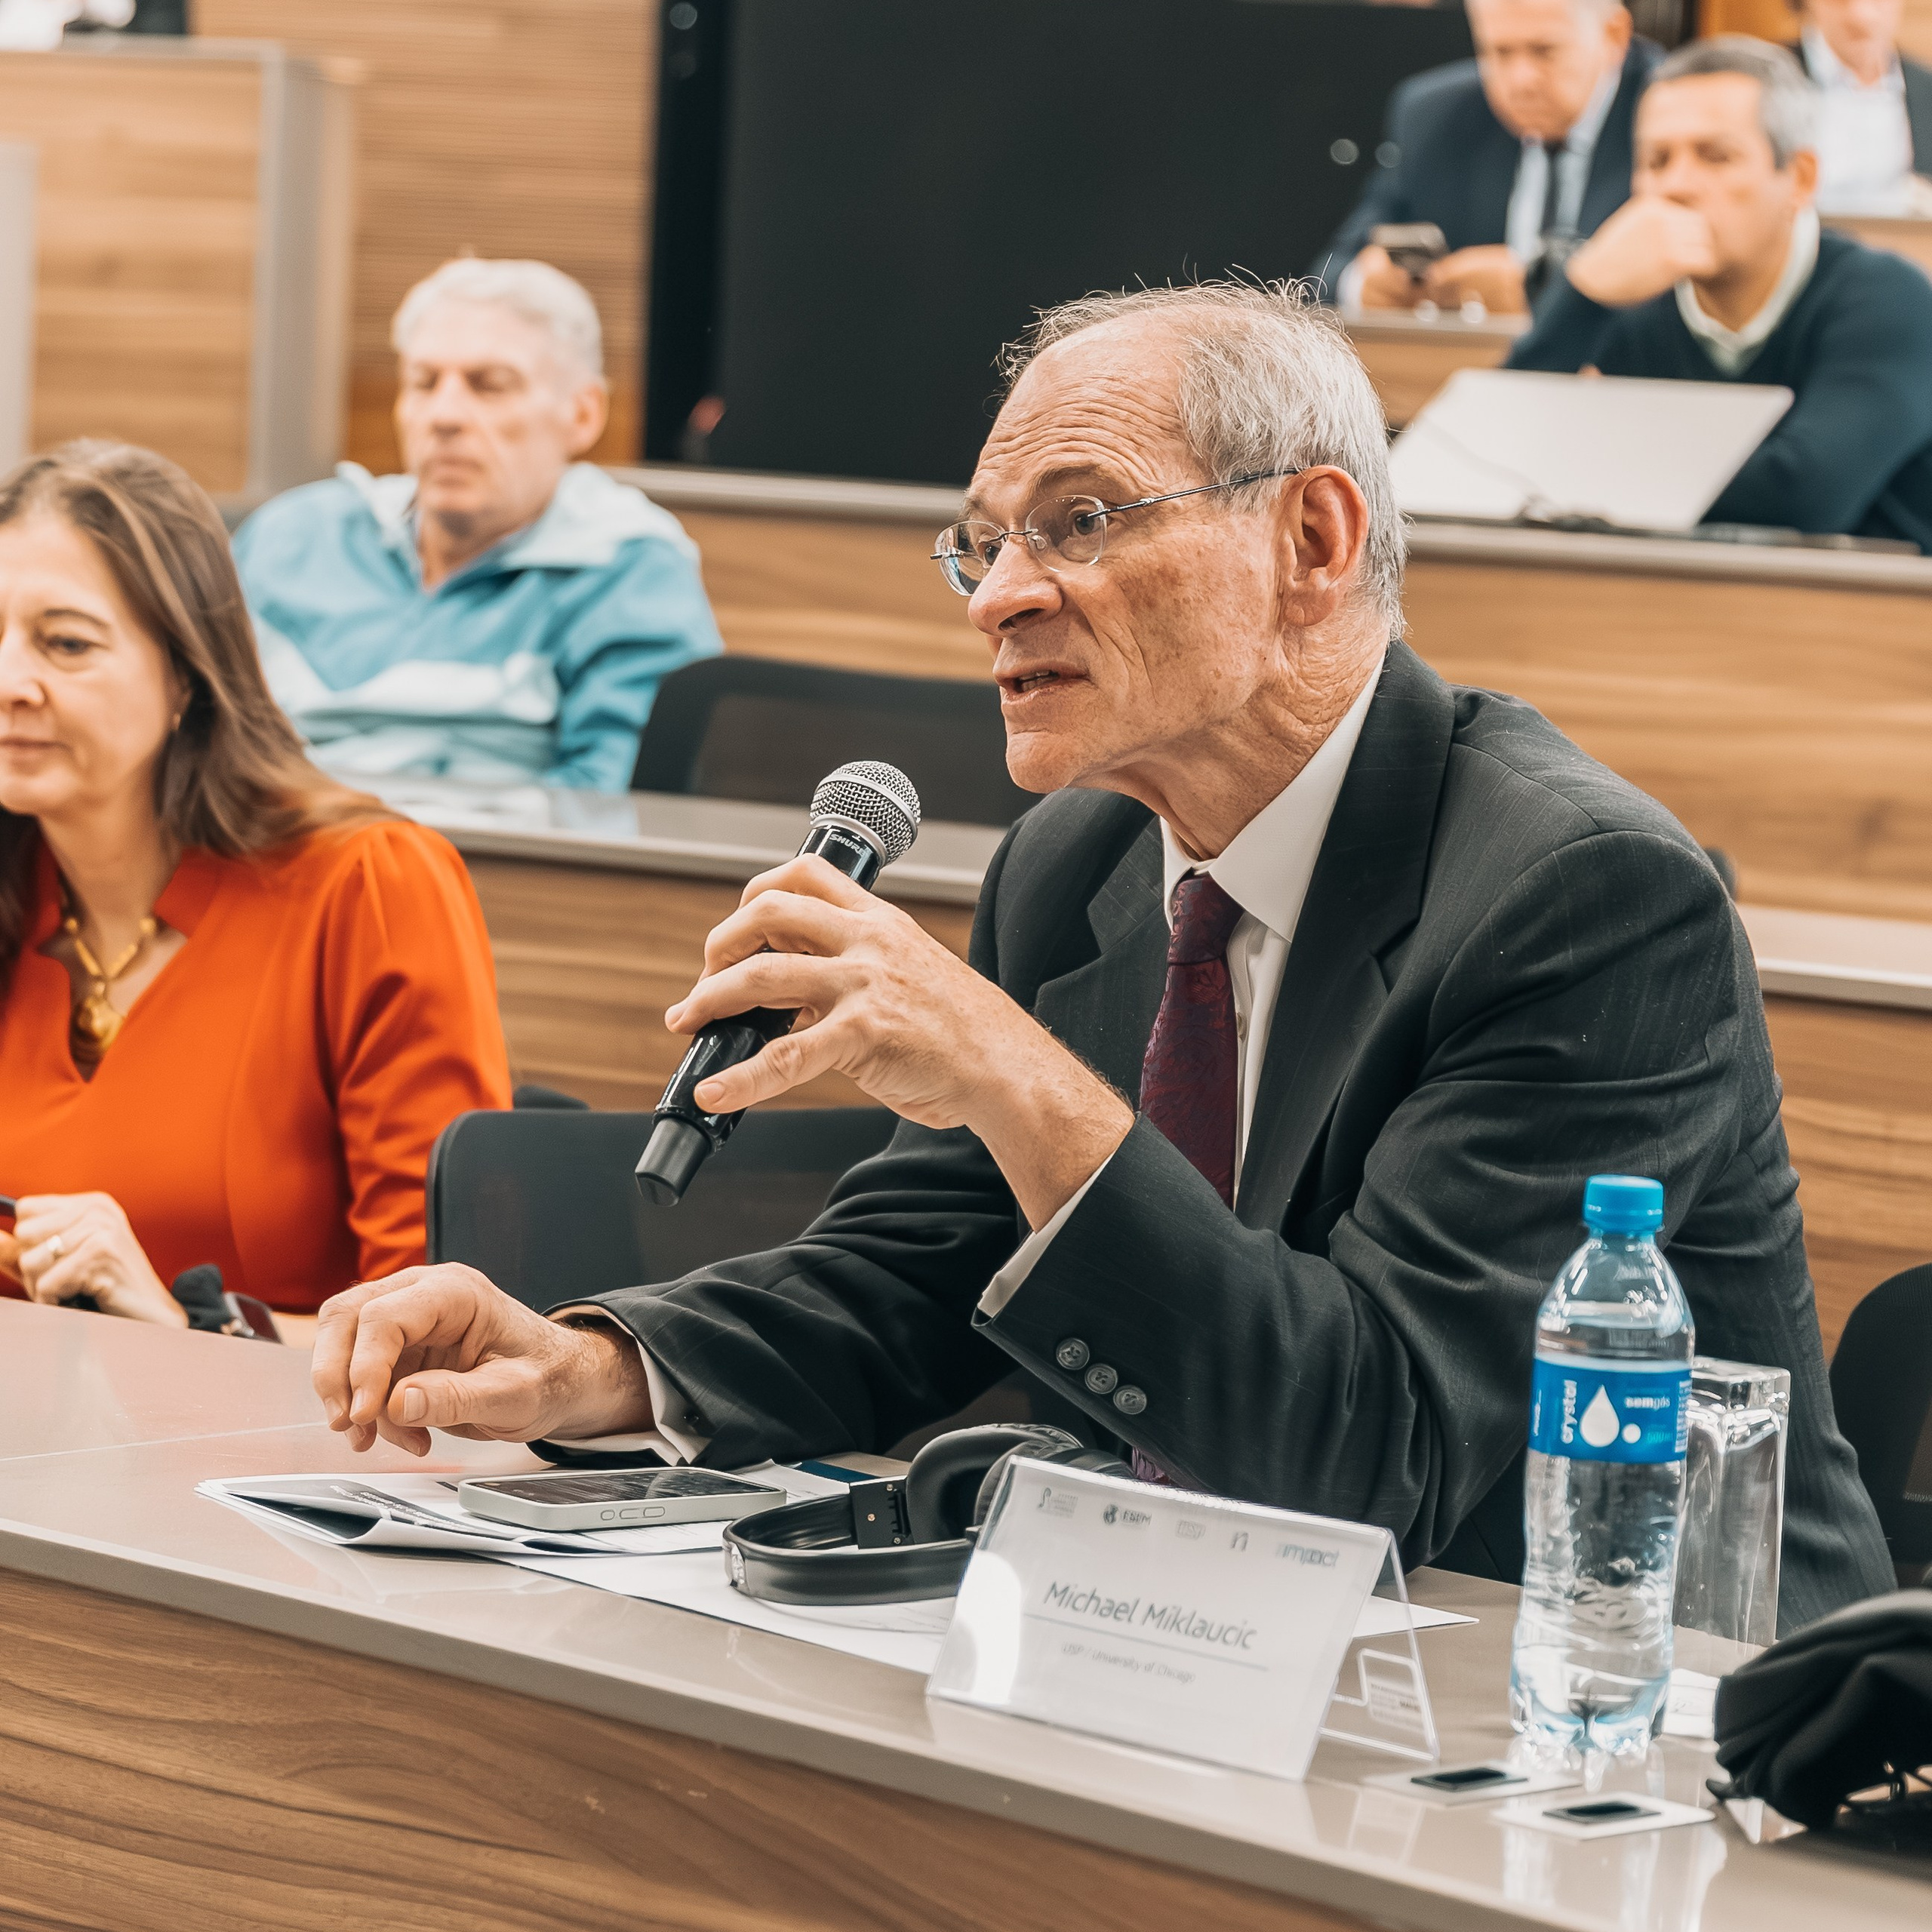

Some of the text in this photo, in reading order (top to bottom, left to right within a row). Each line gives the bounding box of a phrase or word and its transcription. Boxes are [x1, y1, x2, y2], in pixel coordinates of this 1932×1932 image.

[829, 834, 866, 857] SHURE
[1044, 1581, 1258, 1651] Michael Miklaucic
